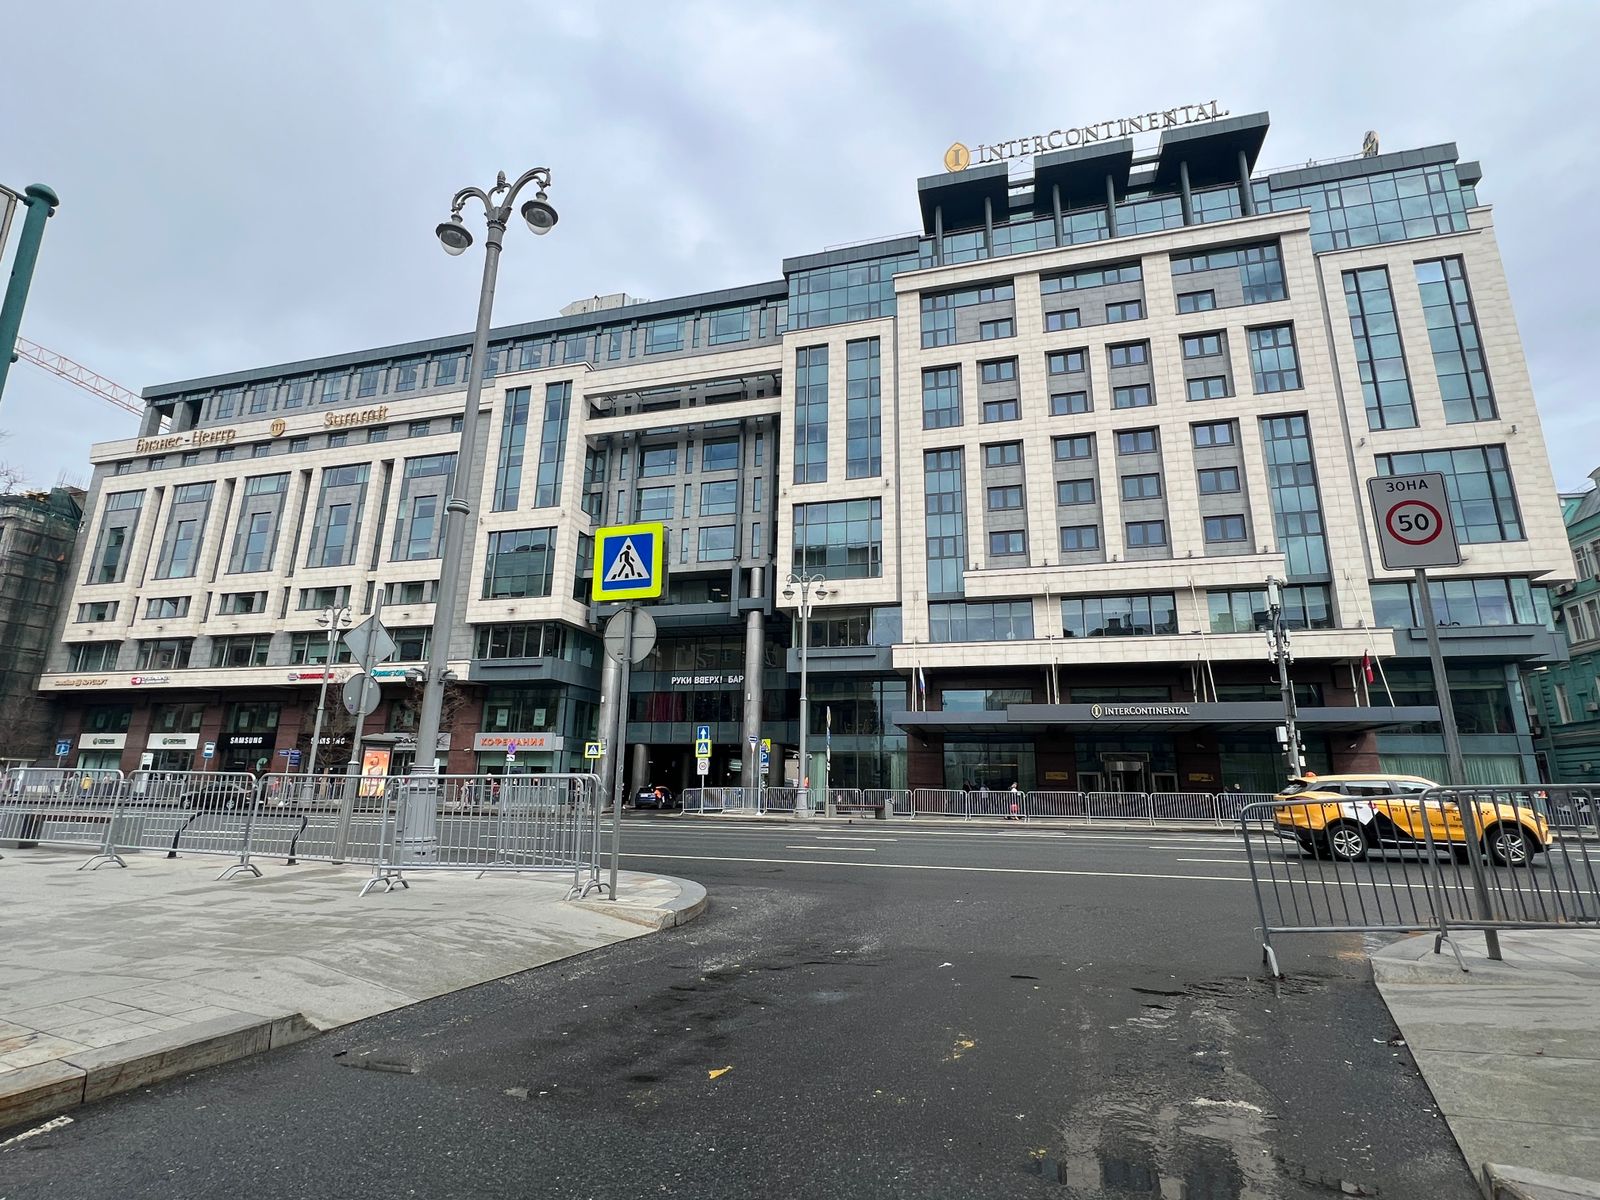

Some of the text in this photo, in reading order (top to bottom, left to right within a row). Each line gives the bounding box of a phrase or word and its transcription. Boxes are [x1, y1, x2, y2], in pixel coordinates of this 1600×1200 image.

[324, 405, 389, 427] Summit
[1385, 479, 1429, 493] ЗОНА
[1397, 513, 1430, 532] 50
[671, 676, 692, 685] РУКИ
[728, 675, 744, 684] БАР
[229, 736, 263, 744] SAMSUNG
[480, 737, 545, 747] КОФЕМАНИЯ
